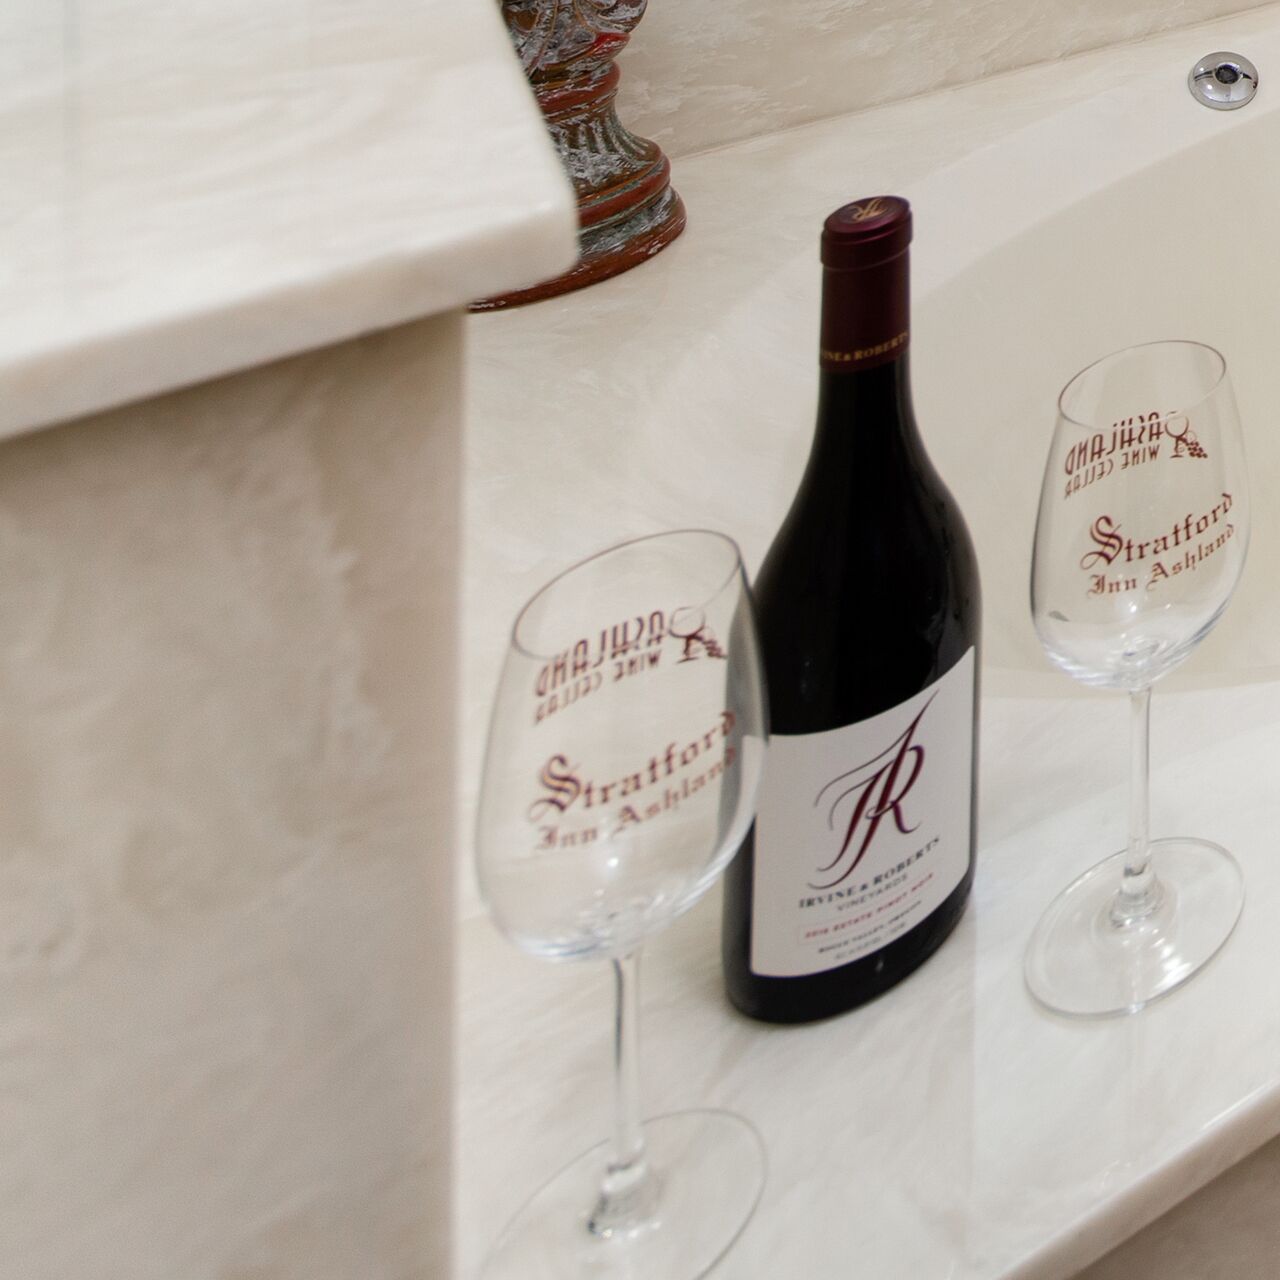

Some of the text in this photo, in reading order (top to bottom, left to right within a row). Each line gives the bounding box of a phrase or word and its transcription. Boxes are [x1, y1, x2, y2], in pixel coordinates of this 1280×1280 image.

[1080, 492, 1233, 570] Stratford
[1087, 524, 1235, 598] Inn Ashland
[529, 710, 736, 821] Stratford
[534, 743, 736, 850] Inn Ashland
[799, 835, 940, 908] IRVINE & ROBERTS
[837, 872, 908, 911] VINEYARDS
[833, 912, 872, 932] ESTATE
